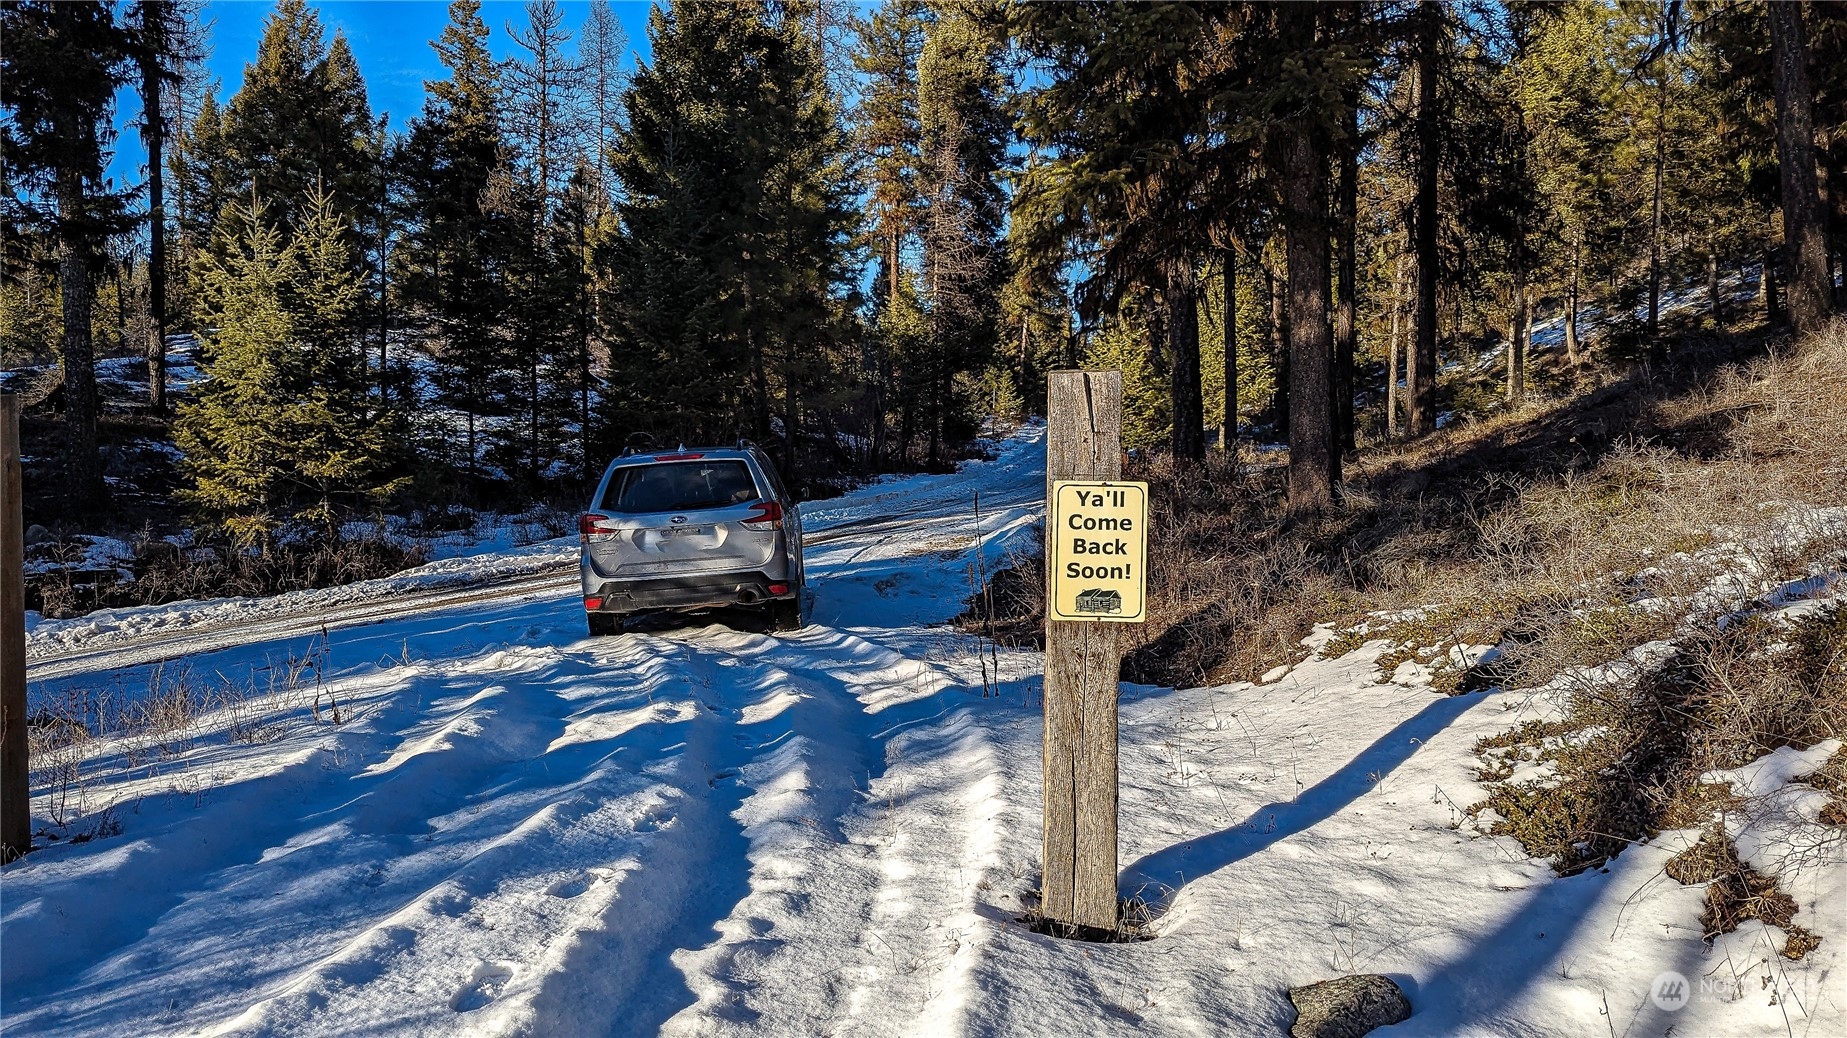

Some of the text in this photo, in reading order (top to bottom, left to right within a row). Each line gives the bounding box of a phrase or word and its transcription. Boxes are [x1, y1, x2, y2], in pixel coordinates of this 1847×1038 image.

[1076, 490, 1125, 507] Ya'll
[1068, 514, 1133, 531] Come
[1073, 538, 1128, 555] Back
[1066, 562, 1131, 579] Soon!
